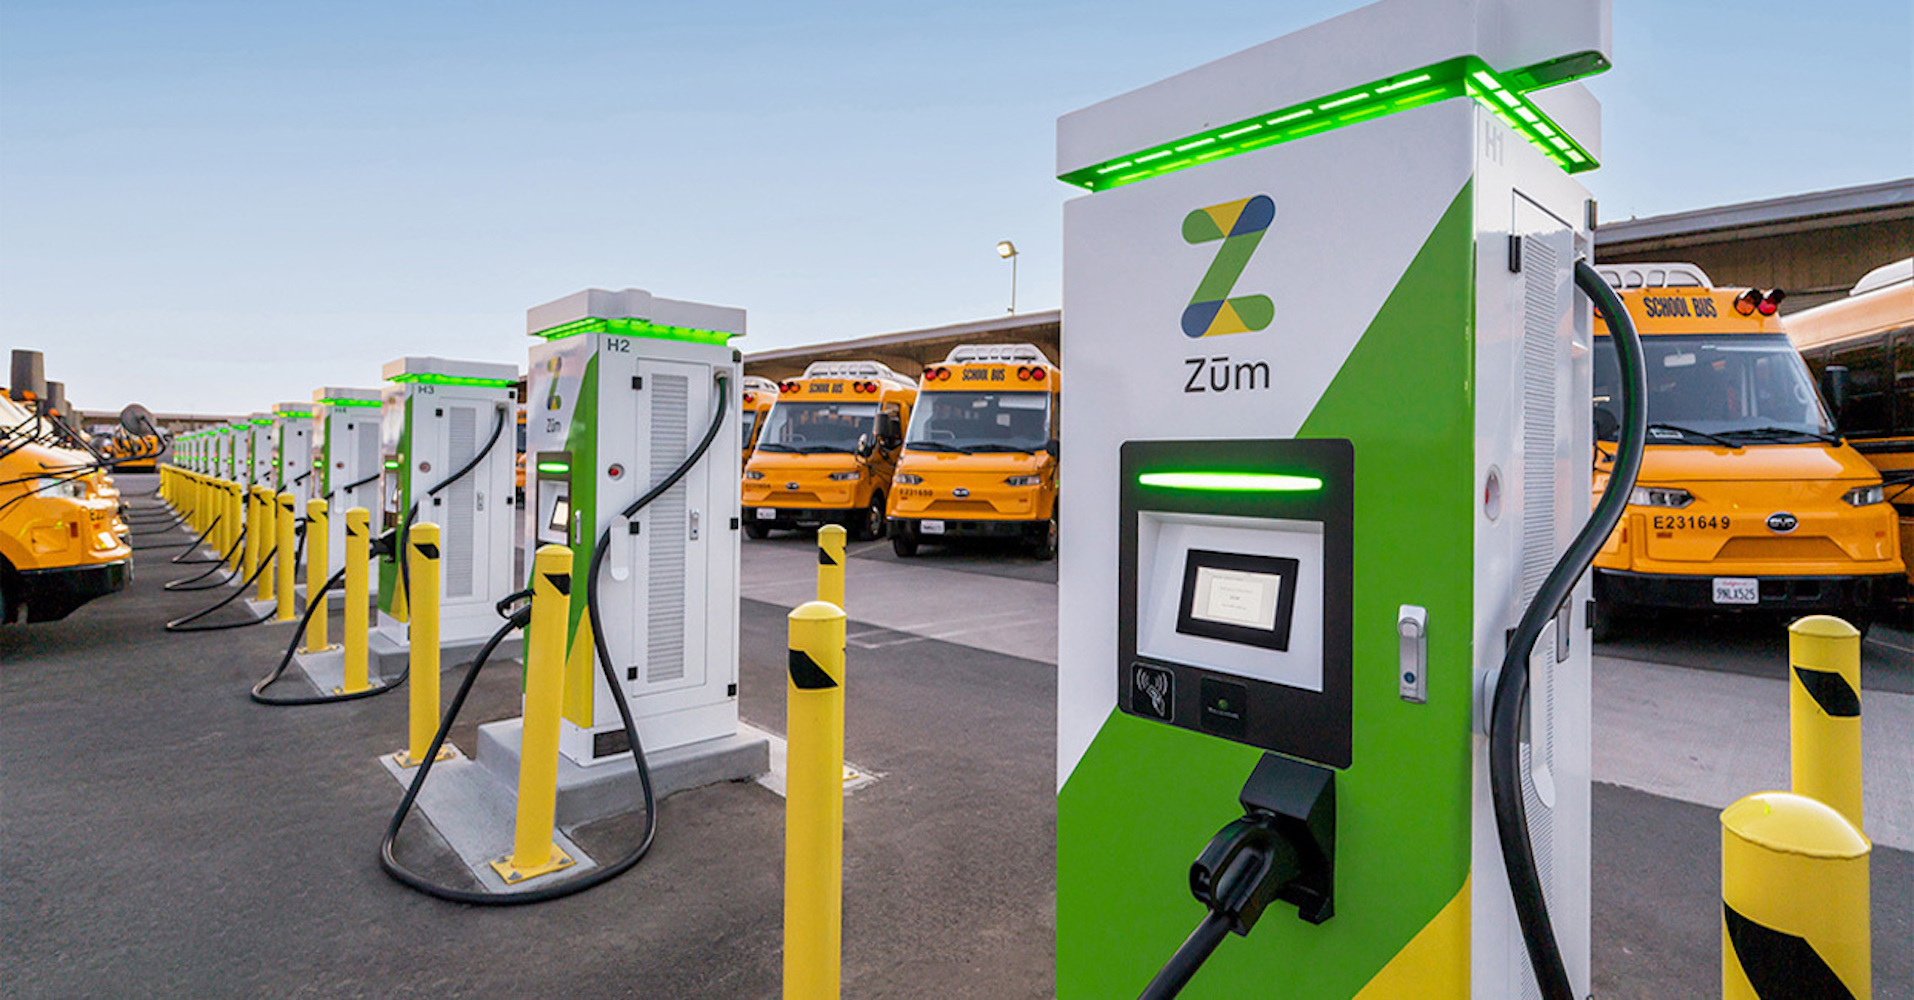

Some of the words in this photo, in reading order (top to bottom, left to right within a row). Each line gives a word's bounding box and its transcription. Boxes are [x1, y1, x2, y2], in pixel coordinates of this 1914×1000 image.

[1485, 120, 1504, 167] H1
[1643, 296, 1691, 318] SCHOOL
[1691, 296, 1718, 318] BUS
[607, 338, 630, 353] H2
[962, 368, 989, 382] SCHOOL
[990, 368, 1005, 382] BUS
[1184, 357, 1270, 393] Zūm
[418, 385, 435, 394] H3
[808, 382, 830, 394] SCHOOL
[831, 382, 844, 394] BUS
[1654, 516, 1730, 530] E231649
